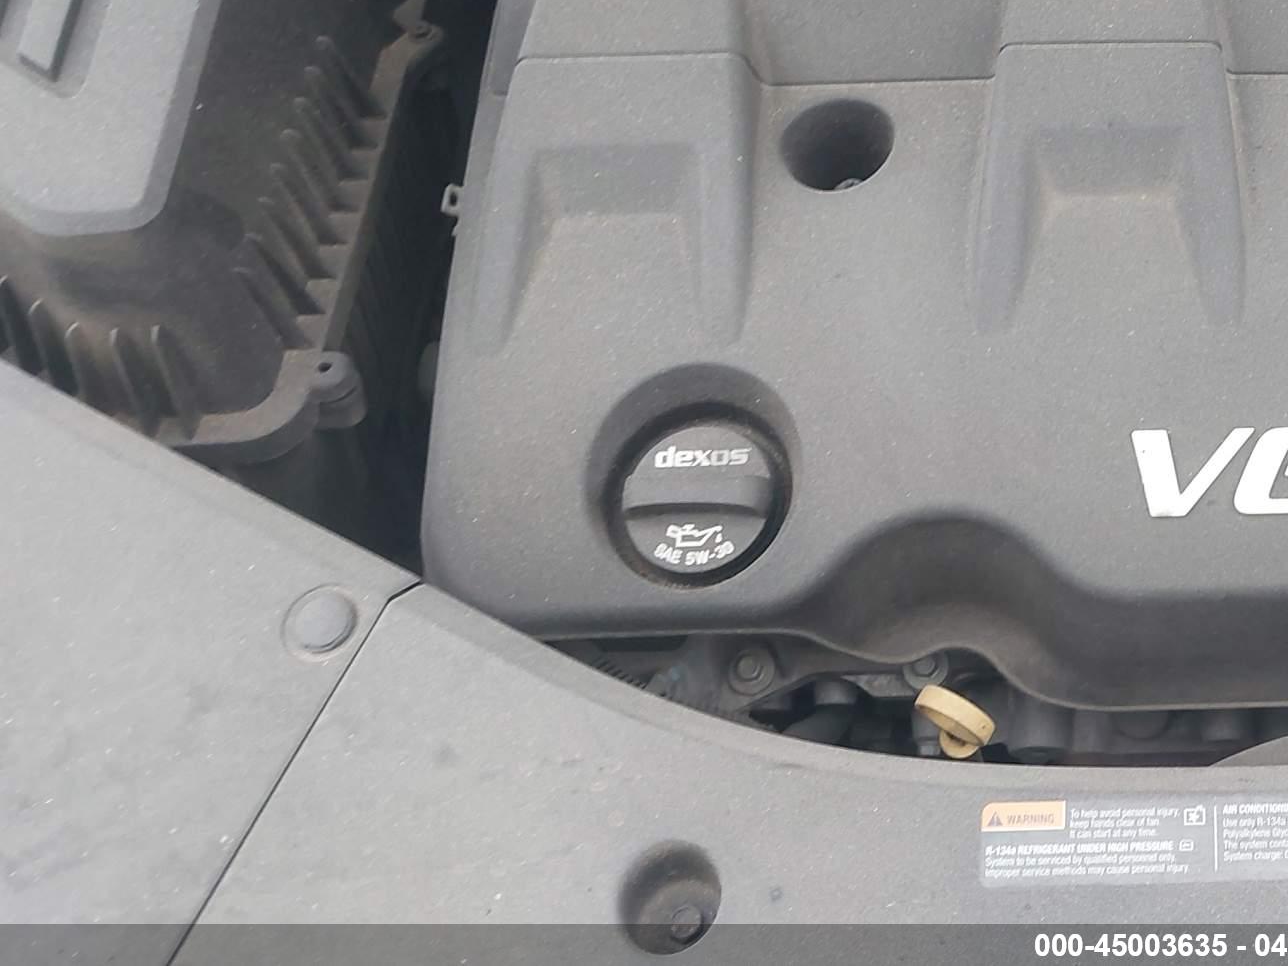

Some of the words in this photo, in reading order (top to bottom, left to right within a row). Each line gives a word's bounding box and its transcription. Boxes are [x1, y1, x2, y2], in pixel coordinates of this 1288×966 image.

[655, 445, 752, 468] dexos
[654, 543, 683, 564] SAE
[685, 540, 735, 565] 5W-30
[1071, 808, 1079, 818] To
[1081, 808, 1098, 820] help
[1100, 808, 1121, 818] avoid
[1122, 807, 1156, 819] personal
[1222, 804, 1238, 814] AIR
[1008, 814, 1054, 824] WARNING
[1070, 820, 1090, 830] keep
[1091, 818, 1114, 828] hands
[1116, 818, 1136, 827] clear
[1136, 817, 1146, 827] of
[1146, 817, 1160, 826] fan
[1223, 818, 1238, 827] Use
[1239, 816, 1256, 828] only
[1256, 816, 1286, 826] R-134a
[1076, 830, 1092, 838] can
[1093, 828, 1112, 838] start
[1112, 829, 1121, 838] at
[1122, 829, 1137, 840] any
[985, 844, 1016, 856] R-134a
[1018, 843, 1076, 854] REFRIGERANT
[1076, 842, 1106, 854] UNDER
[1108, 842, 1128, 852] HIGH
[1130, 840, 1174, 852] PRESSURE
[1224, 840, 1238, 850] The
[1240, 839, 1268, 851] system
[984, 856, 1015, 868] System
[1016, 857, 1024, 866] to
[1025, 856, 1036, 866] be
[1037, 855, 1071, 865] serviced
[1072, 854, 1083, 866] by
[1084, 854, 1118, 865] qualified
[1118, 853, 1158, 864] personnel
[1224, 851, 1252, 863] System
[984, 868, 1020, 878] Improper
[1022, 867, 1051, 878] service
[1052, 865, 1087, 876] methods
[1088, 866, 1106, 876] may
[1107, 865, 1131, 874] cause
[1131, 864, 1166, 874] personal
